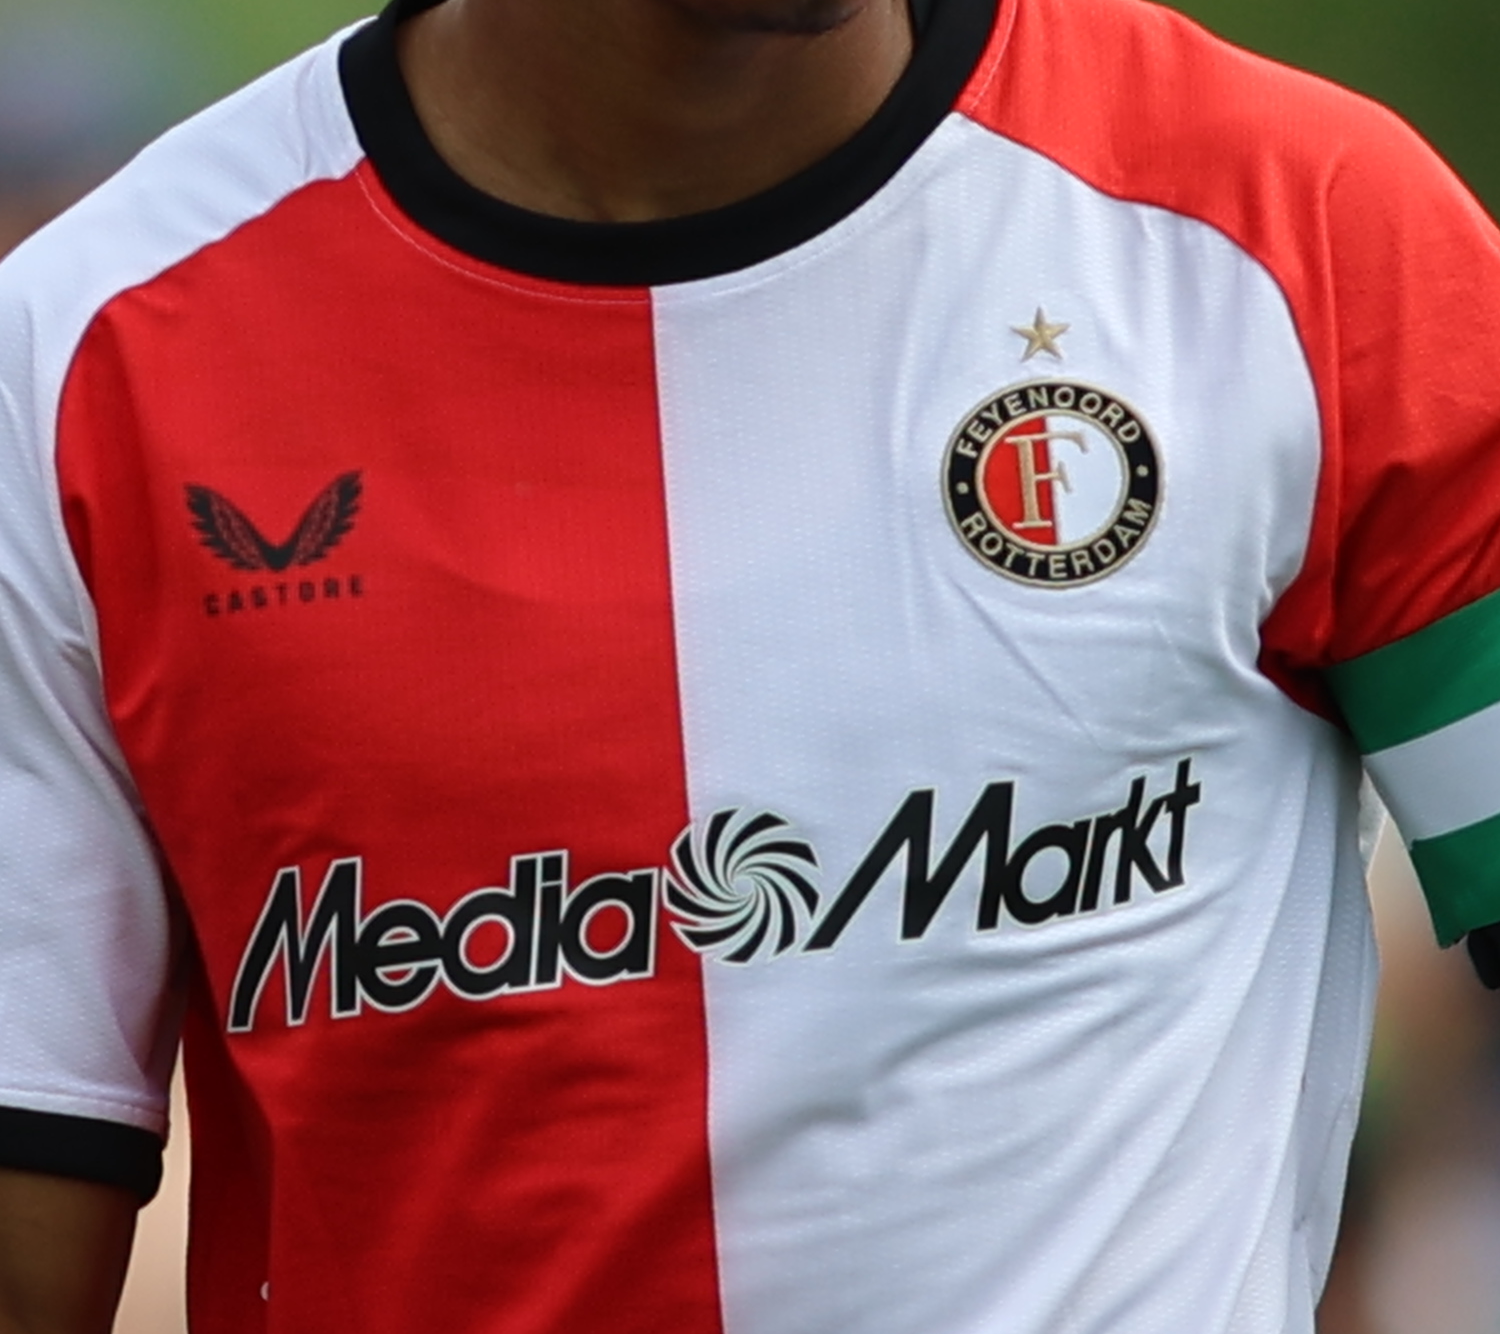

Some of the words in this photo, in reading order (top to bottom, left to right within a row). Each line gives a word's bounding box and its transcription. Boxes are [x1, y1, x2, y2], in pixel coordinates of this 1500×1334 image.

[956, 386, 1141, 458] FEYENOORD
[961, 498, 1152, 578] ROTTERDAM
[203, 574, 363, 617] CASTORE
[226, 849, 664, 1032] Media
[799, 755, 1201, 954] Markt
